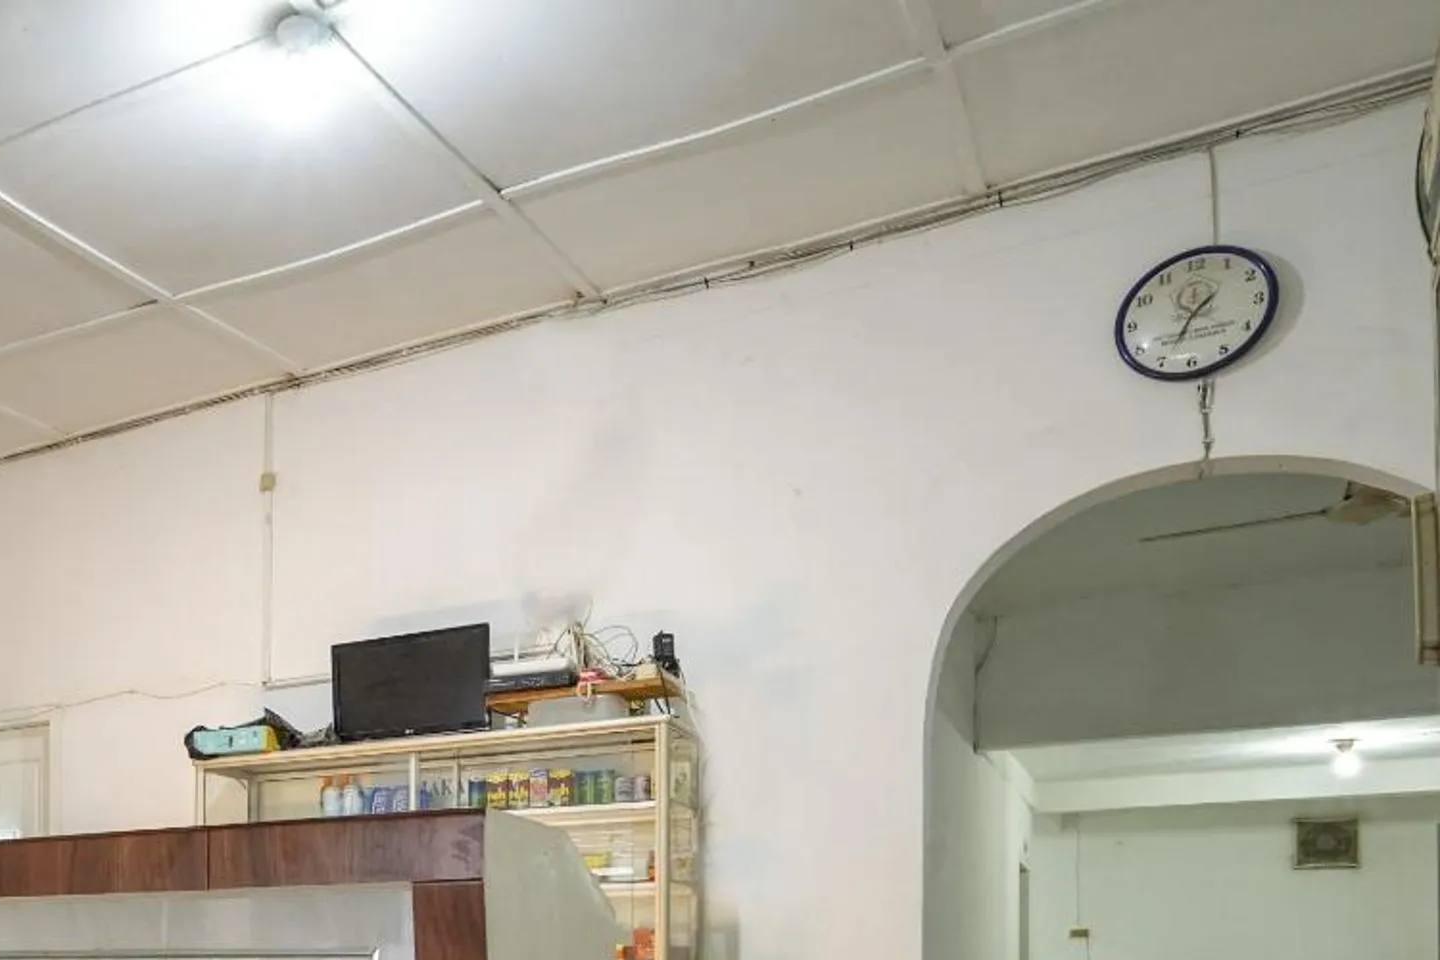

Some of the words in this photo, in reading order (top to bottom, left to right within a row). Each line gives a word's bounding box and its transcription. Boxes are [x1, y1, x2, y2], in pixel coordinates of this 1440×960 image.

[1223, 258, 1231, 270] 1
[1158, 272, 1172, 286] 11
[1244, 269, 1257, 282] 2
[1136, 293, 1153, 308] 10
[1253, 291, 1265, 305] 3
[1127, 321, 1138, 333] 9
[1219, 344, 1229, 355] 5
[1156, 357, 1167, 368] 7
[1186, 356, 1197, 367] 6
